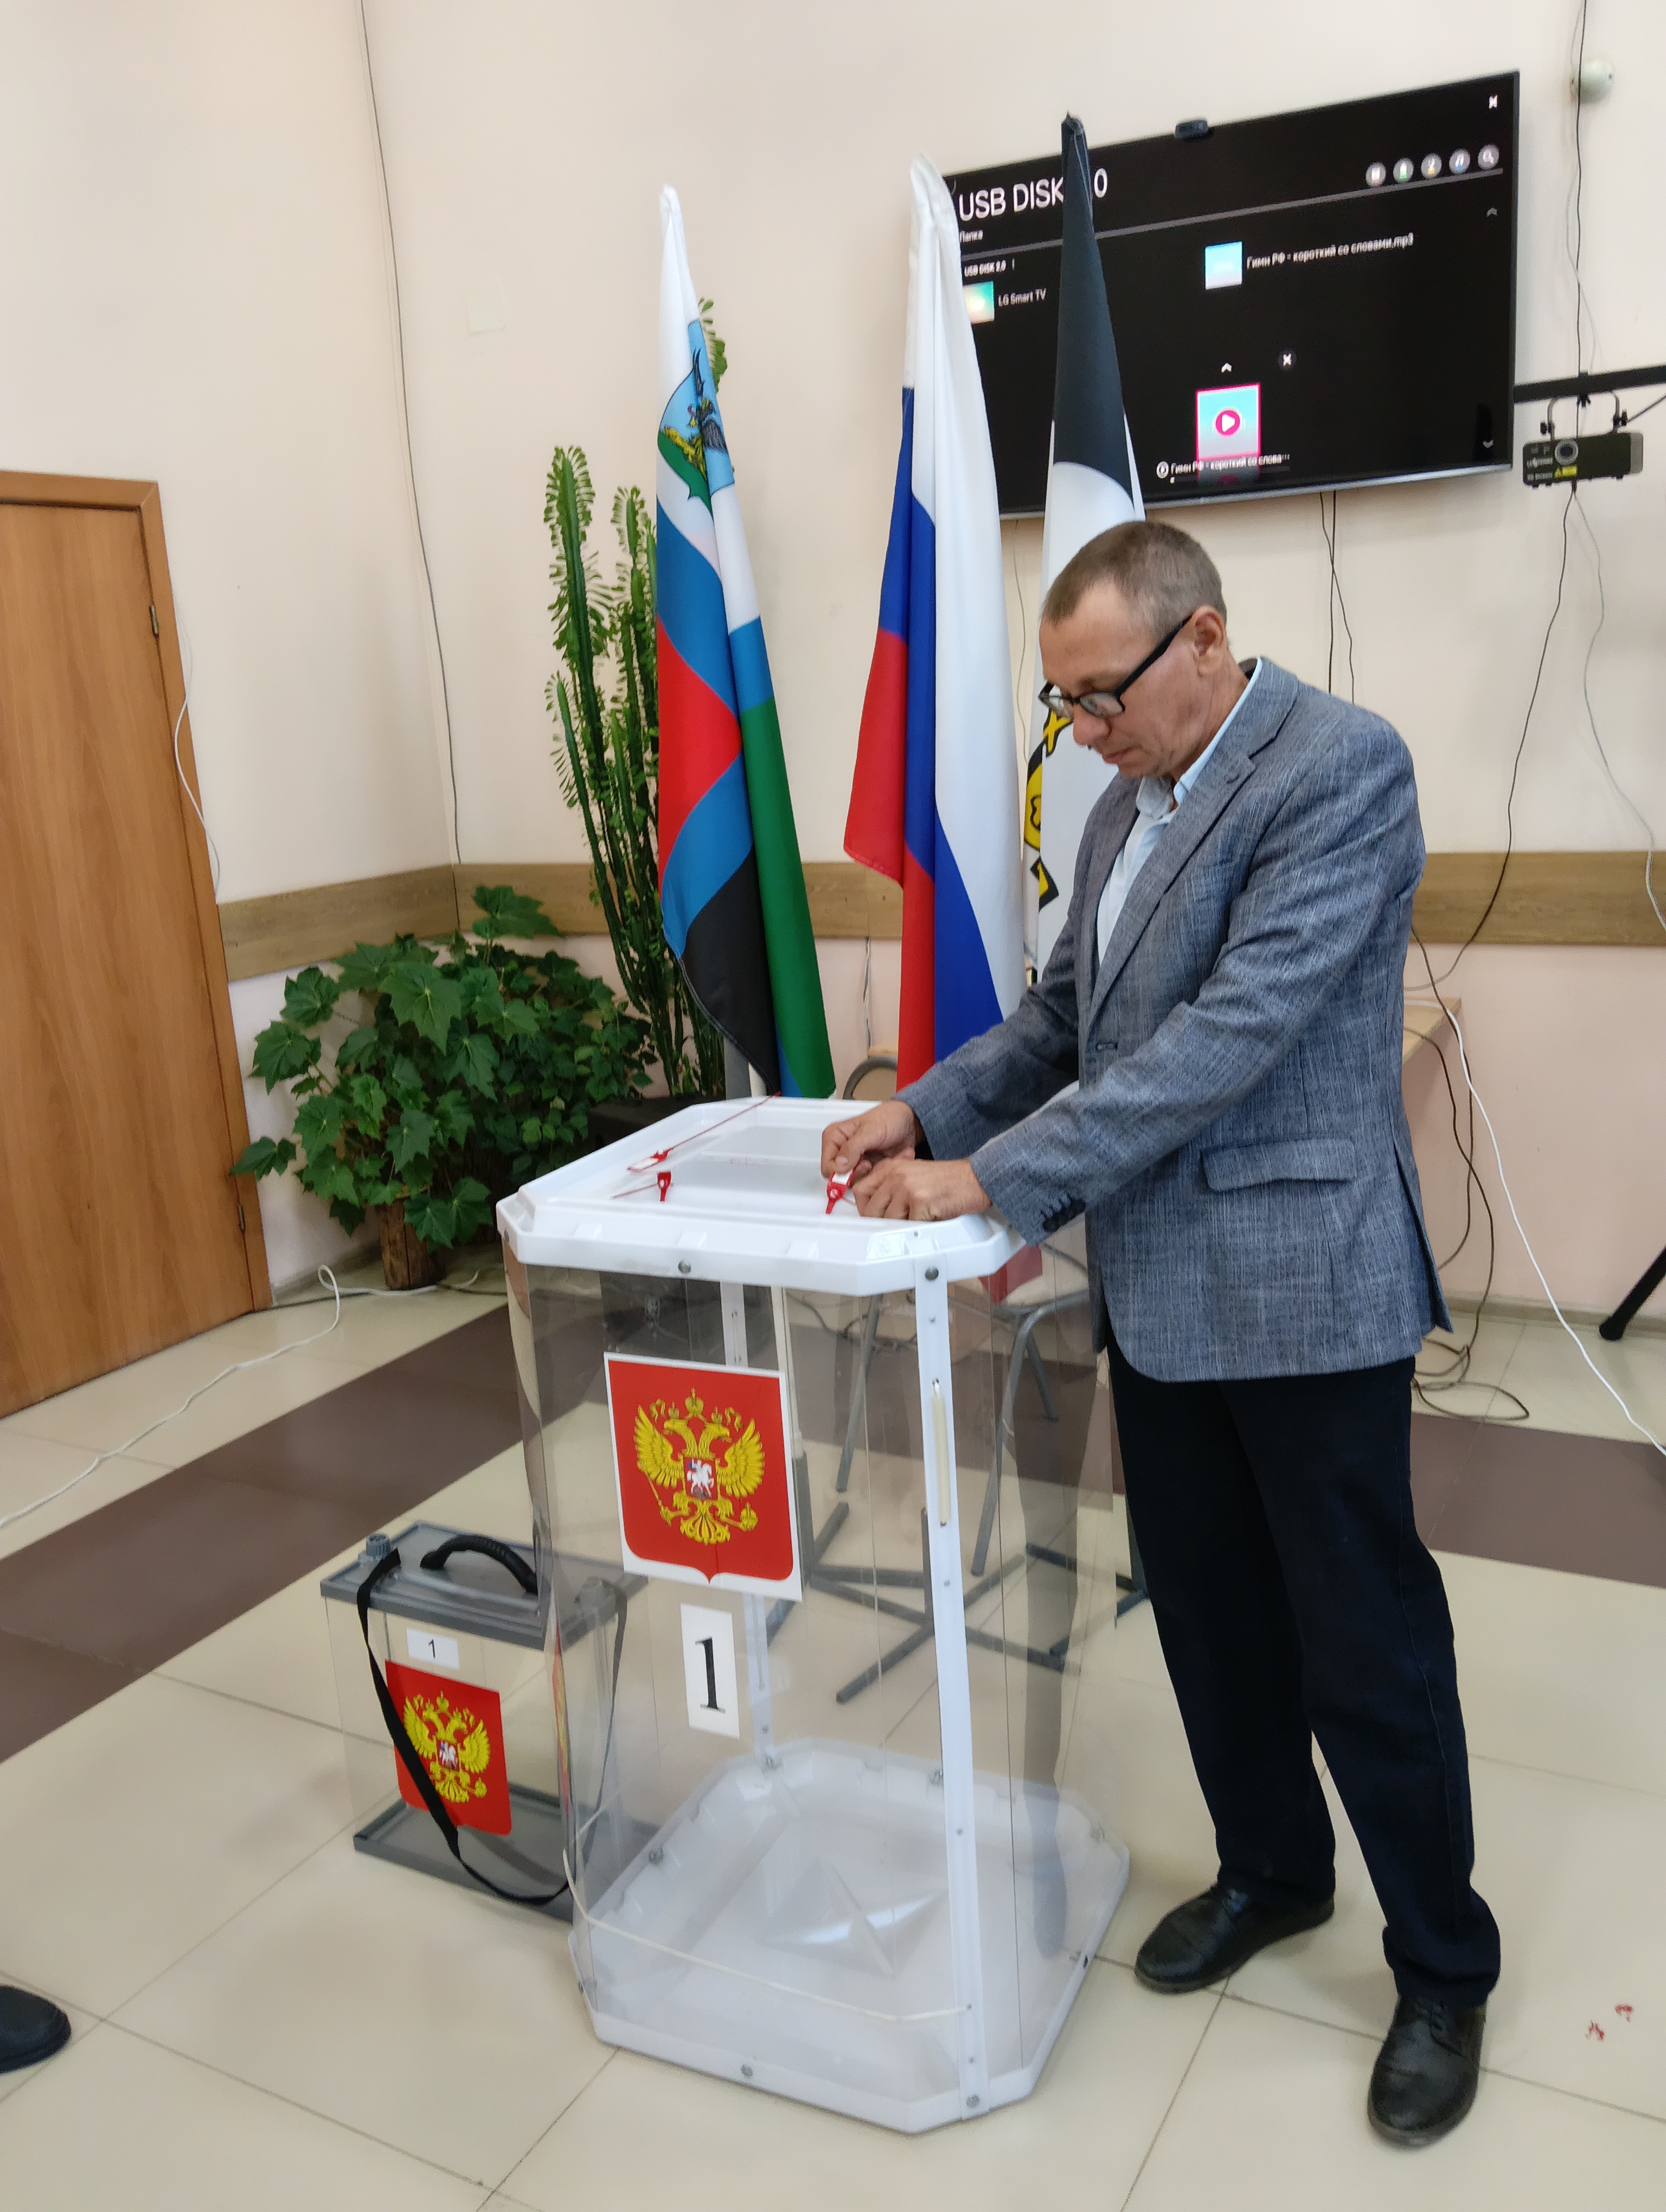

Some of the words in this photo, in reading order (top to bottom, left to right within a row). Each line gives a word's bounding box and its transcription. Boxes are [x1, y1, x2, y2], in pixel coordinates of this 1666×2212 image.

[959, 188, 1005, 221] USB
[1013, 177, 1063, 213] DISK
[1272, 252, 1285, 265] РФ
[964, 265, 978, 277] USB
[998, 293, 1009, 306] LG
[1010, 291, 1033, 305] Smart
[1035, 288, 1046, 301] TV
[428, 1638, 435, 1658] 1
[695, 1637, 726, 1714] 1
